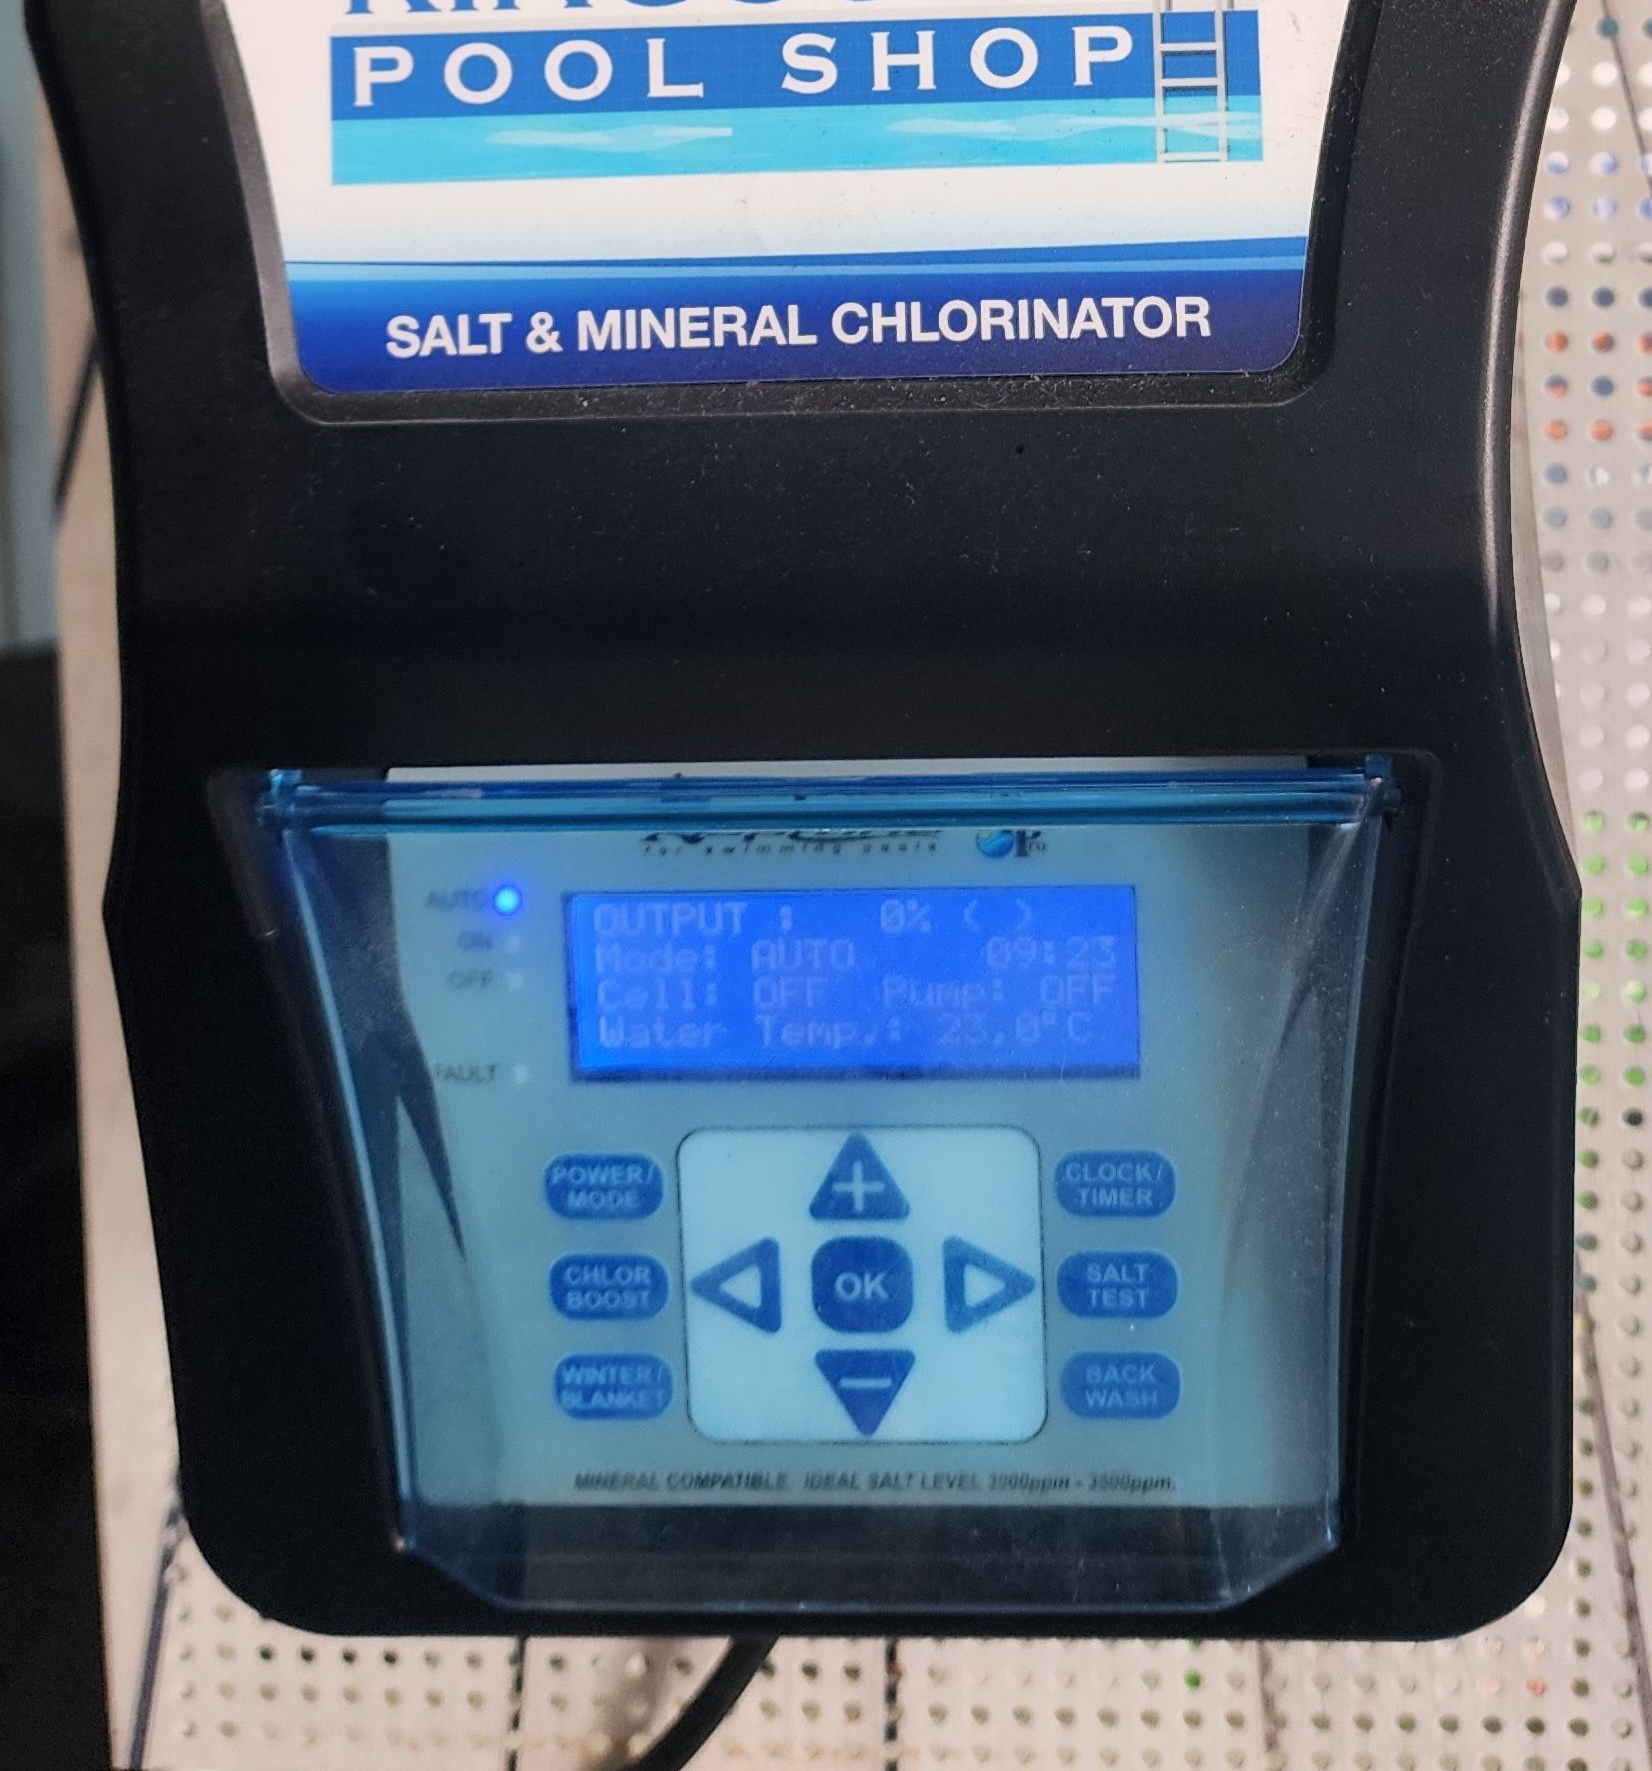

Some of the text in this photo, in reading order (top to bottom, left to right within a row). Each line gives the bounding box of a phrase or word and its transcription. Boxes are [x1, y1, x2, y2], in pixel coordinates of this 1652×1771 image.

[352, 25, 1134, 108] POOL SHOP
[385, 295, 1212, 361] SALT & MINERAL CHLORINATOR
[594, 901, 748, 935] OUTPUT
[595, 934, 1118, 974] Mode: AUTO 09:23
[597, 972, 1117, 1012] Cell: OFF Pump: OFF
[600, 1015, 728, 1049] Water
[567, 1189, 641, 1210] MODE
[1078, 1186, 1154, 1208] TIMER
[564, 1264, 651, 1286] CHLOR
[1086, 1262, 1150, 1284] SALT
[834, 1271, 889, 1302] OK
[566, 1289, 651, 1311] BOOST
[1086, 1287, 1149, 1309] TEST
[1085, 1363, 1157, 1385] BACK
[561, 1389, 669, 1411] BLANKET
[1084, 1388, 1158, 1410] WASH
